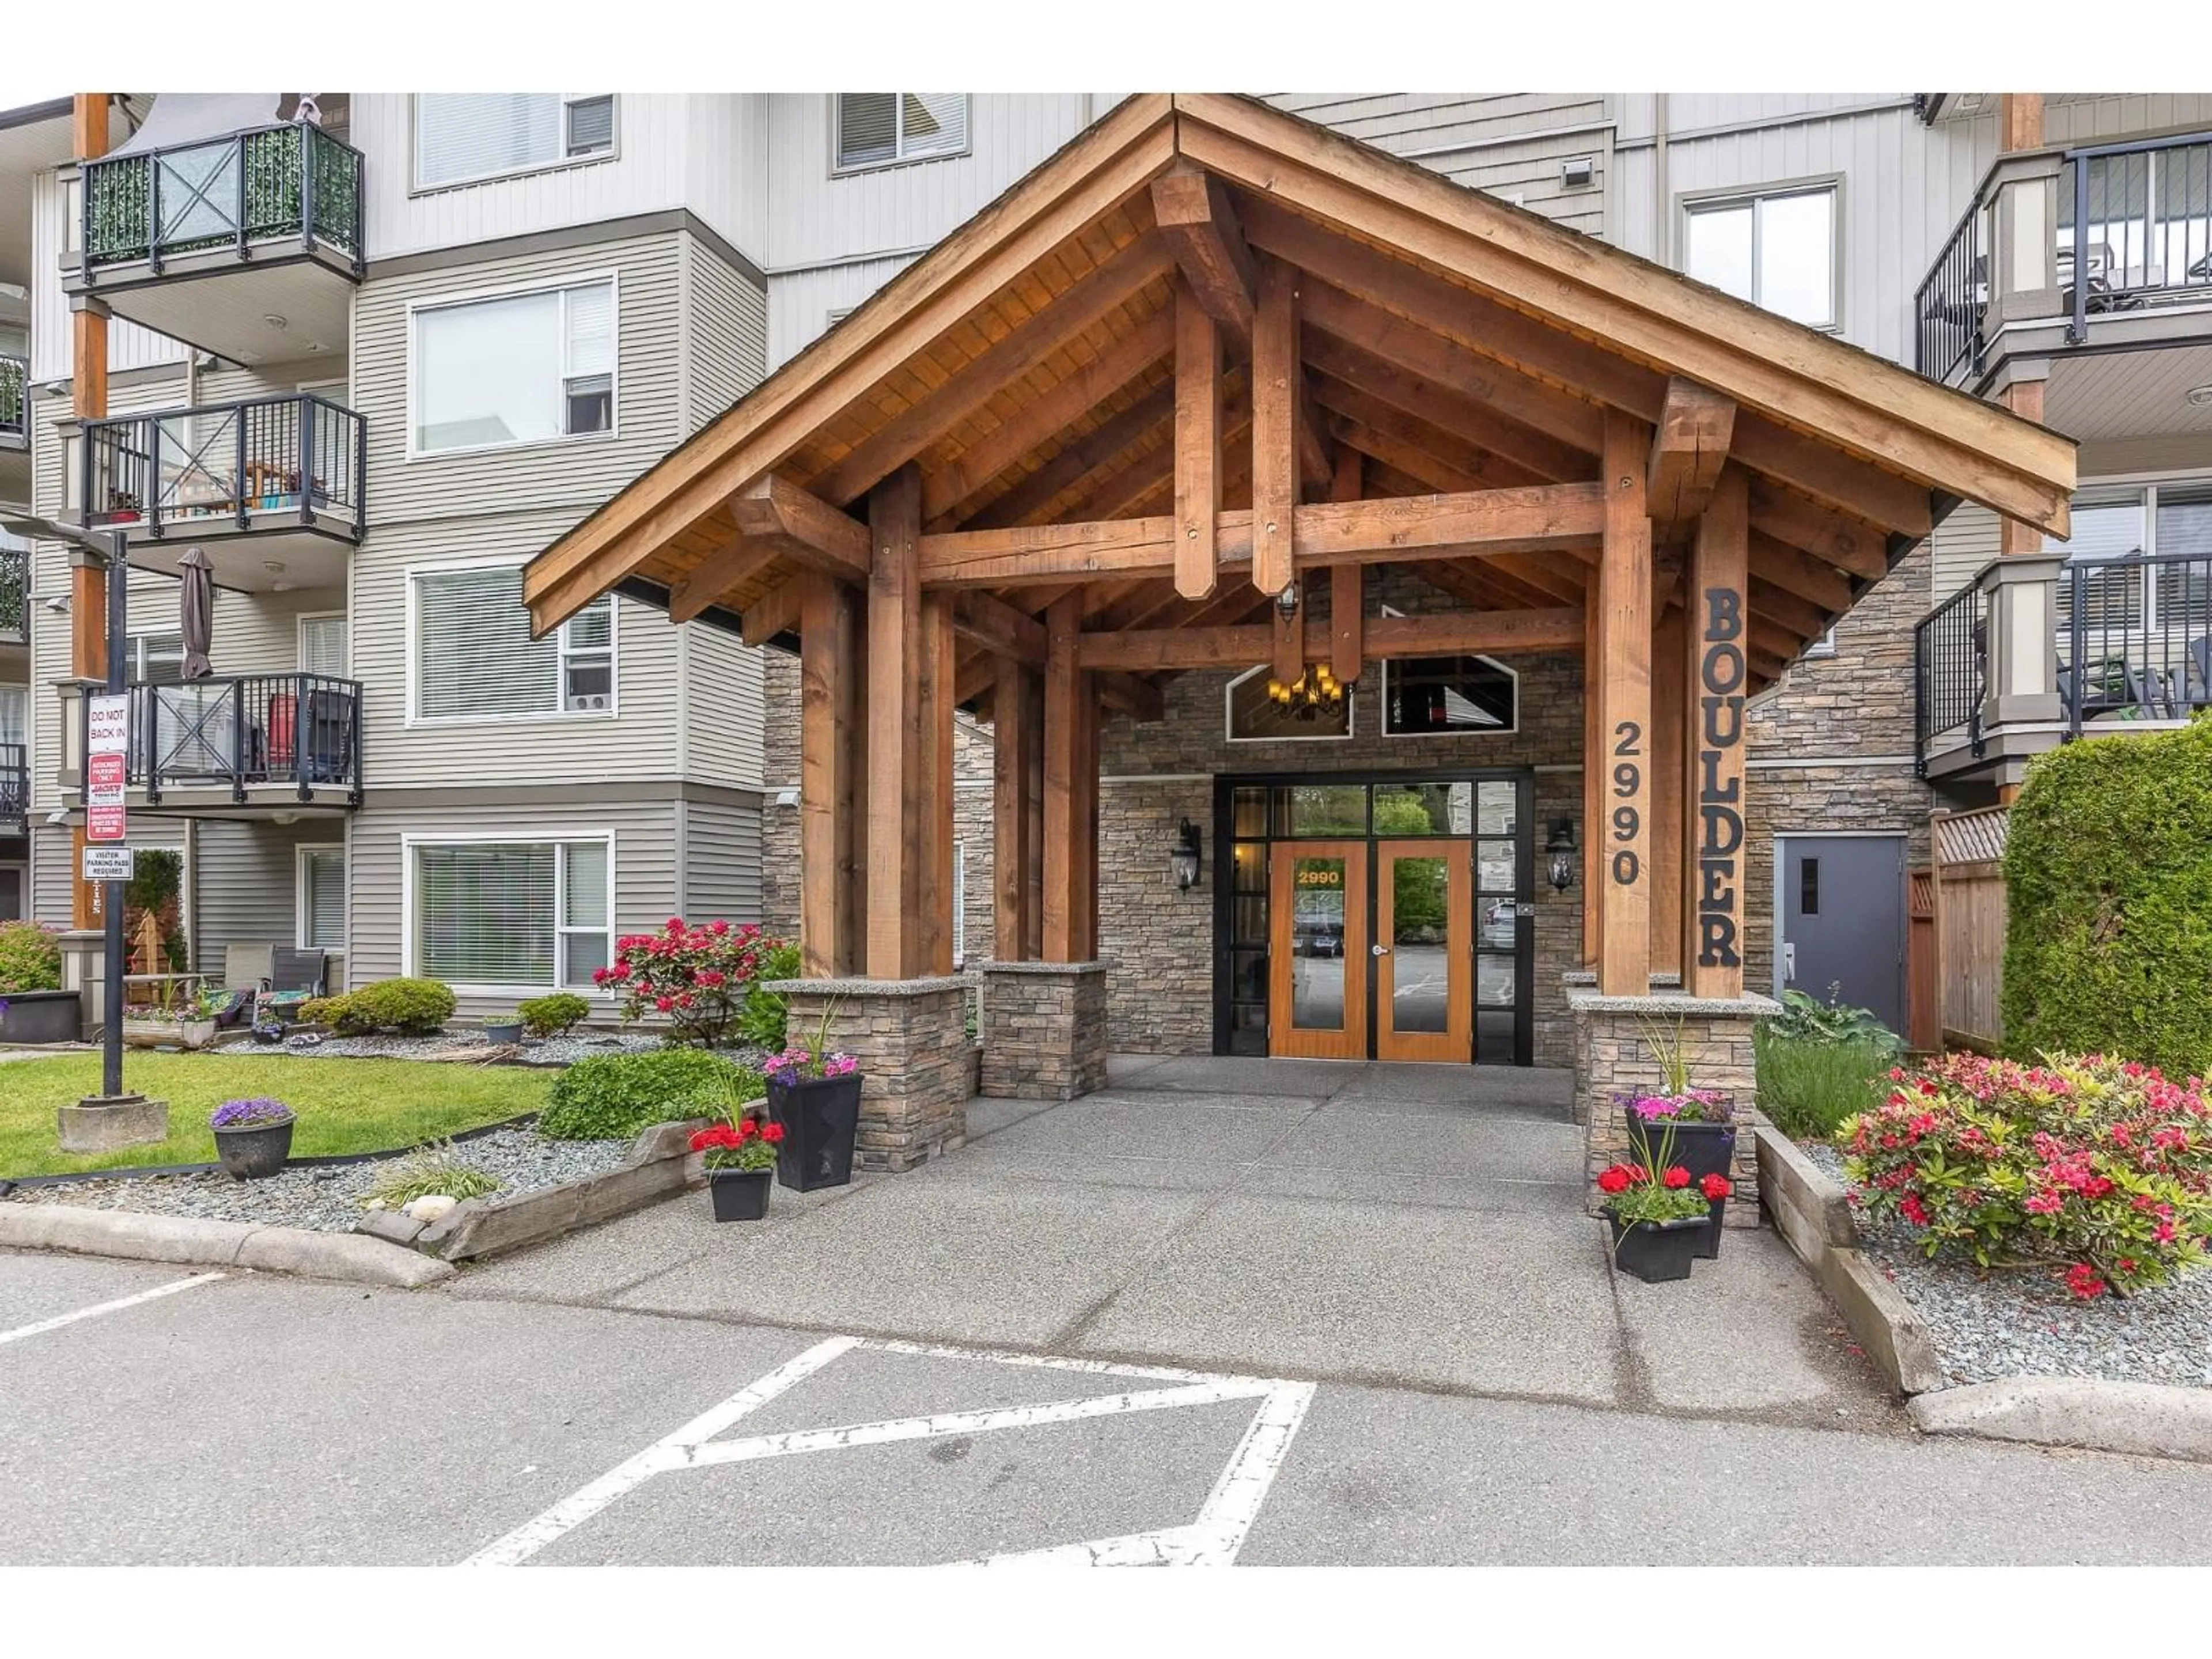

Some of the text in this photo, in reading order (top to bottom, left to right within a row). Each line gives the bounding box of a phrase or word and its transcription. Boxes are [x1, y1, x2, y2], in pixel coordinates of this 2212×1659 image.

[92, 709, 124, 721] DO NOT
[91, 728, 126, 739] BACK IN
[1699, 587, 1744, 967] BOULDER
[1613, 721, 1641, 885] 2990
[1298, 871, 1339, 883] 2990
